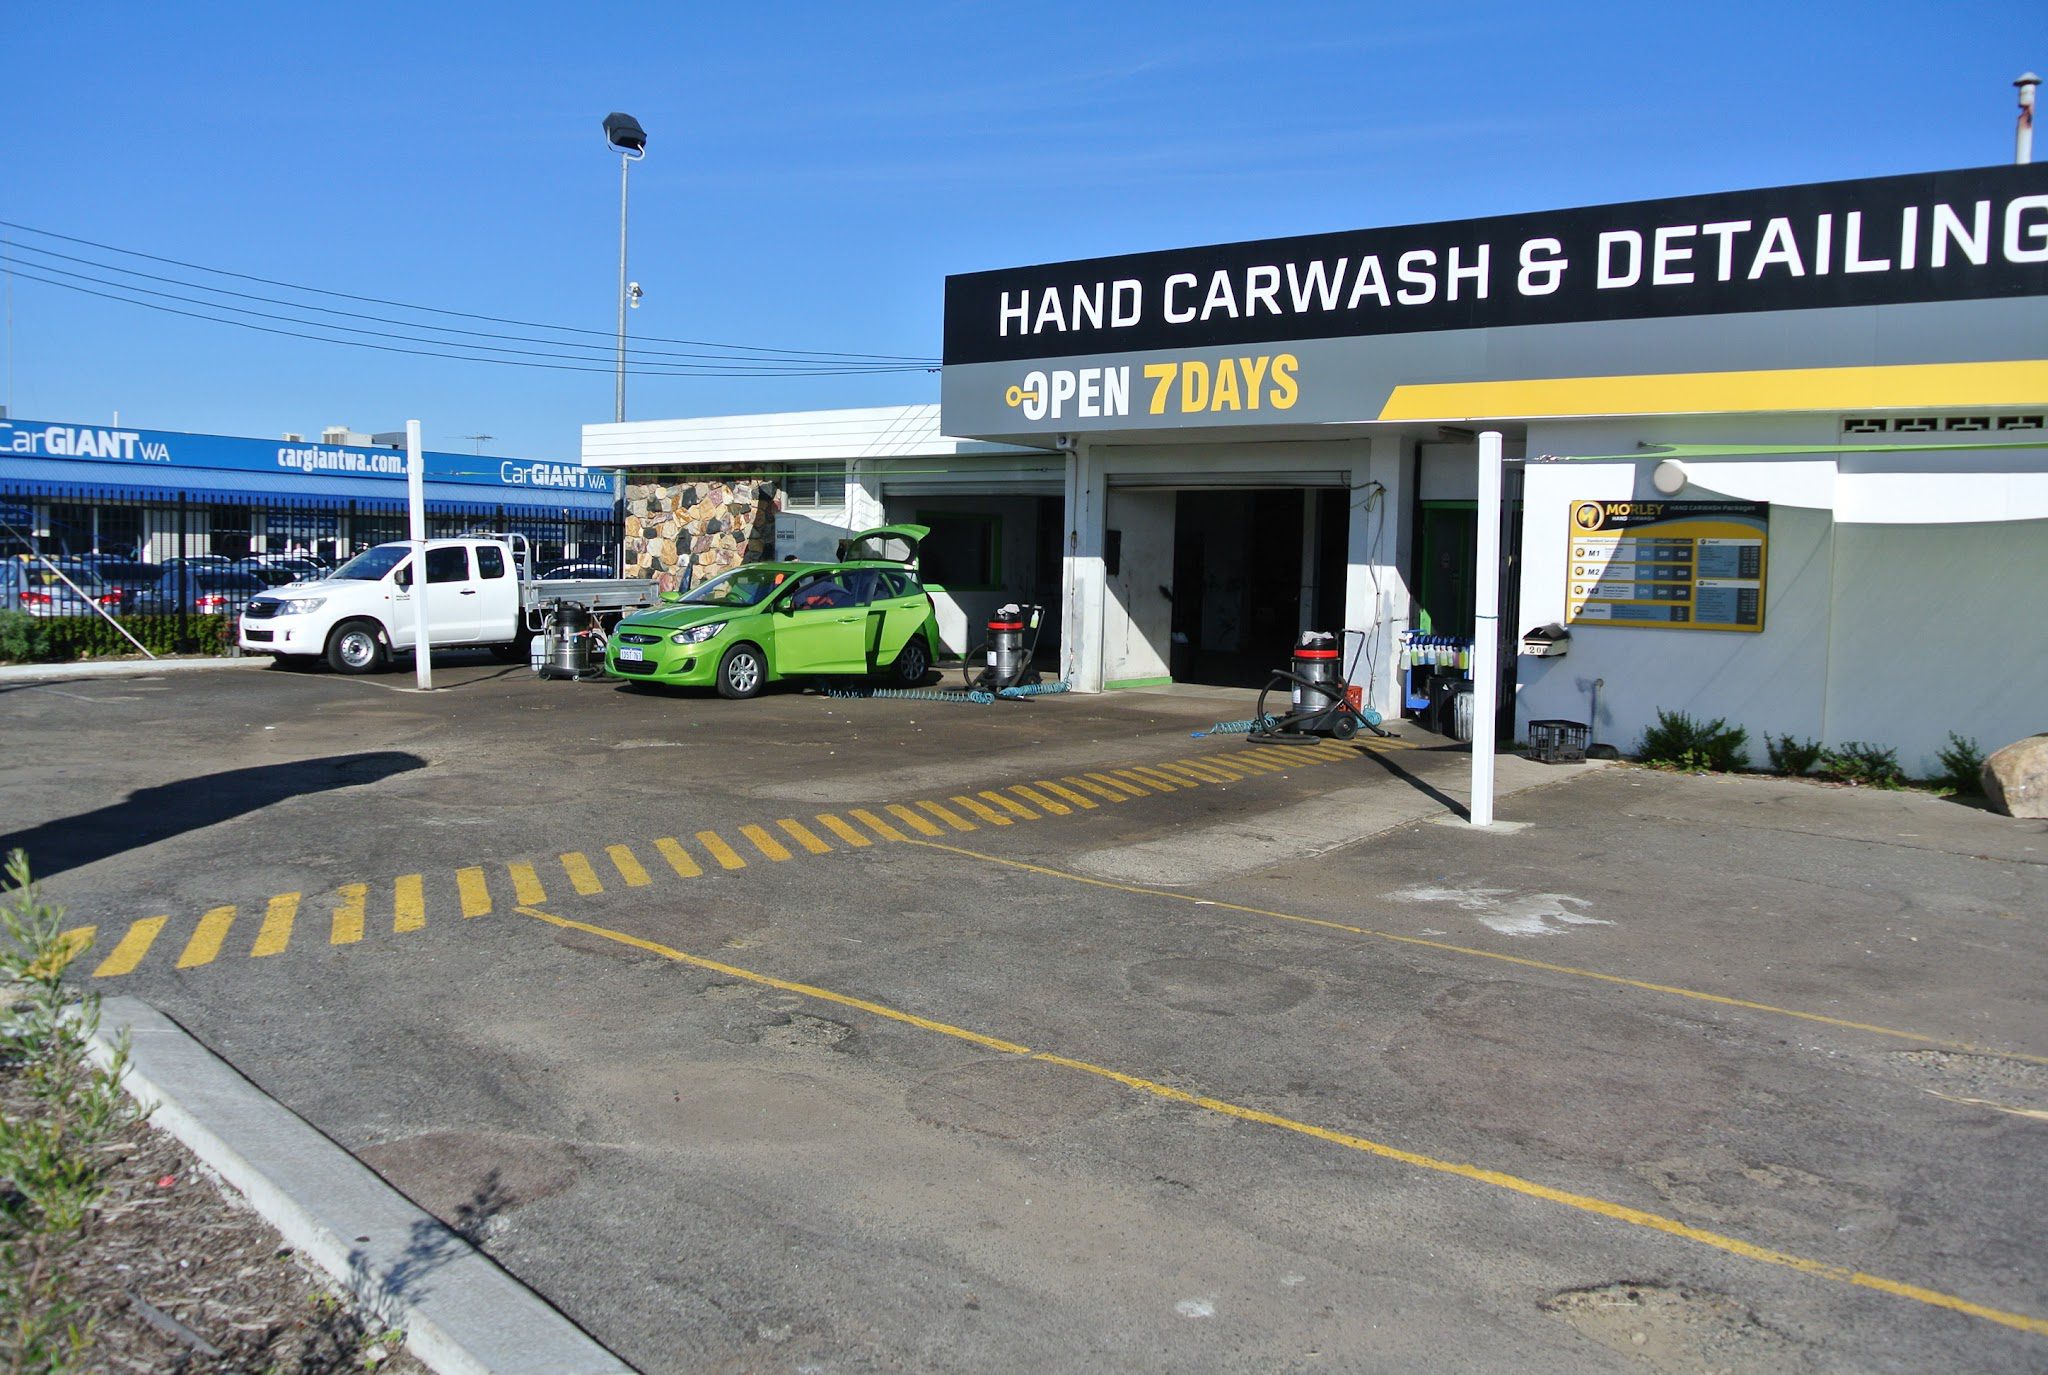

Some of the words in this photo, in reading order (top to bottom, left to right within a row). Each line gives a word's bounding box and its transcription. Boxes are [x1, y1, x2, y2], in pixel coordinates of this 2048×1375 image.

[999, 279, 1143, 337] HAND
[1163, 244, 1490, 324] CARWASH
[1517, 237, 1569, 296] &
[1596, 194, 2048, 290] DETAILING
[1022, 365, 1130, 421] OPEN
[138, 442, 171, 462] WA
[277, 445, 424, 474] cargiantwa.com.
[501, 461, 589, 488] CarGIANT
[587, 475, 607, 490] WA
[1605, 503, 1665, 516] MORLEY
